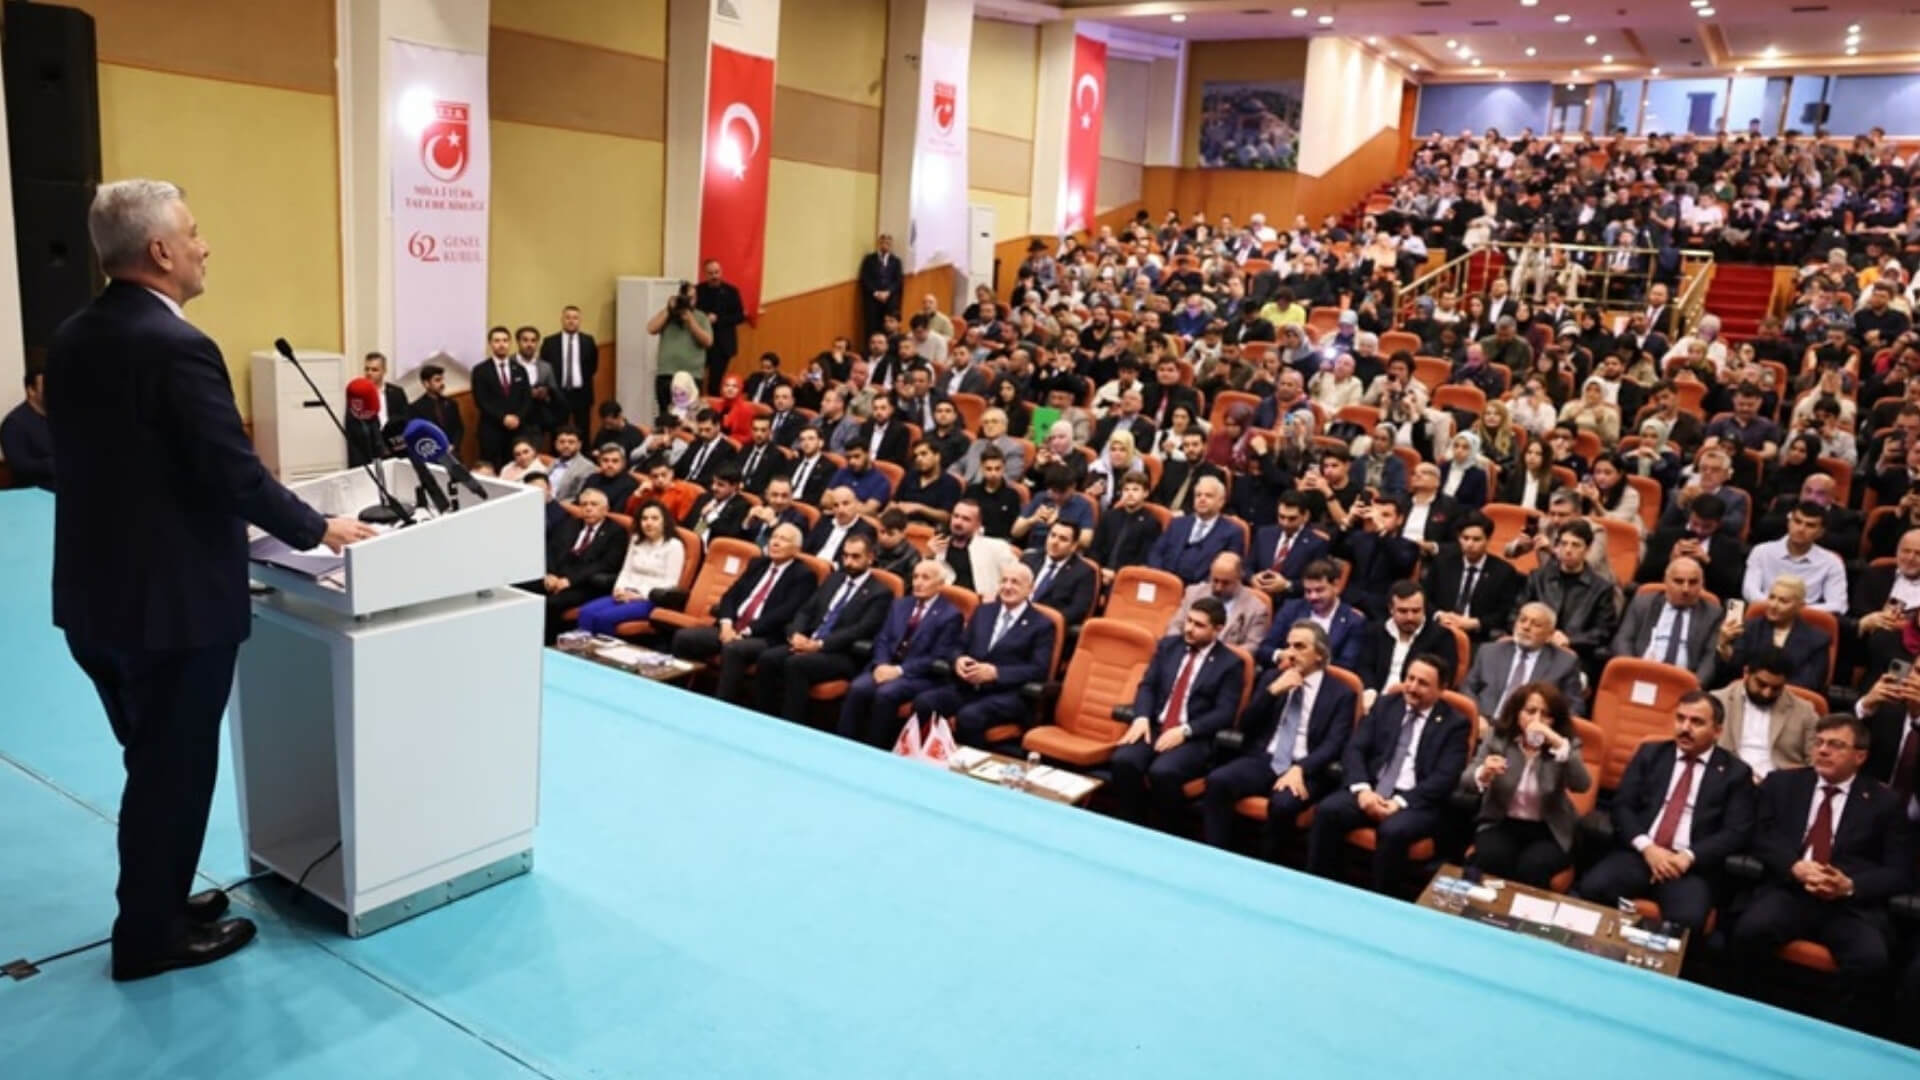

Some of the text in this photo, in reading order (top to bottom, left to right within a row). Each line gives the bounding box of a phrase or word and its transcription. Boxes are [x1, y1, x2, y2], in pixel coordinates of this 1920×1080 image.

[408, 230, 480, 262] 62 GENEL
[443, 250, 481, 263] KURUL
